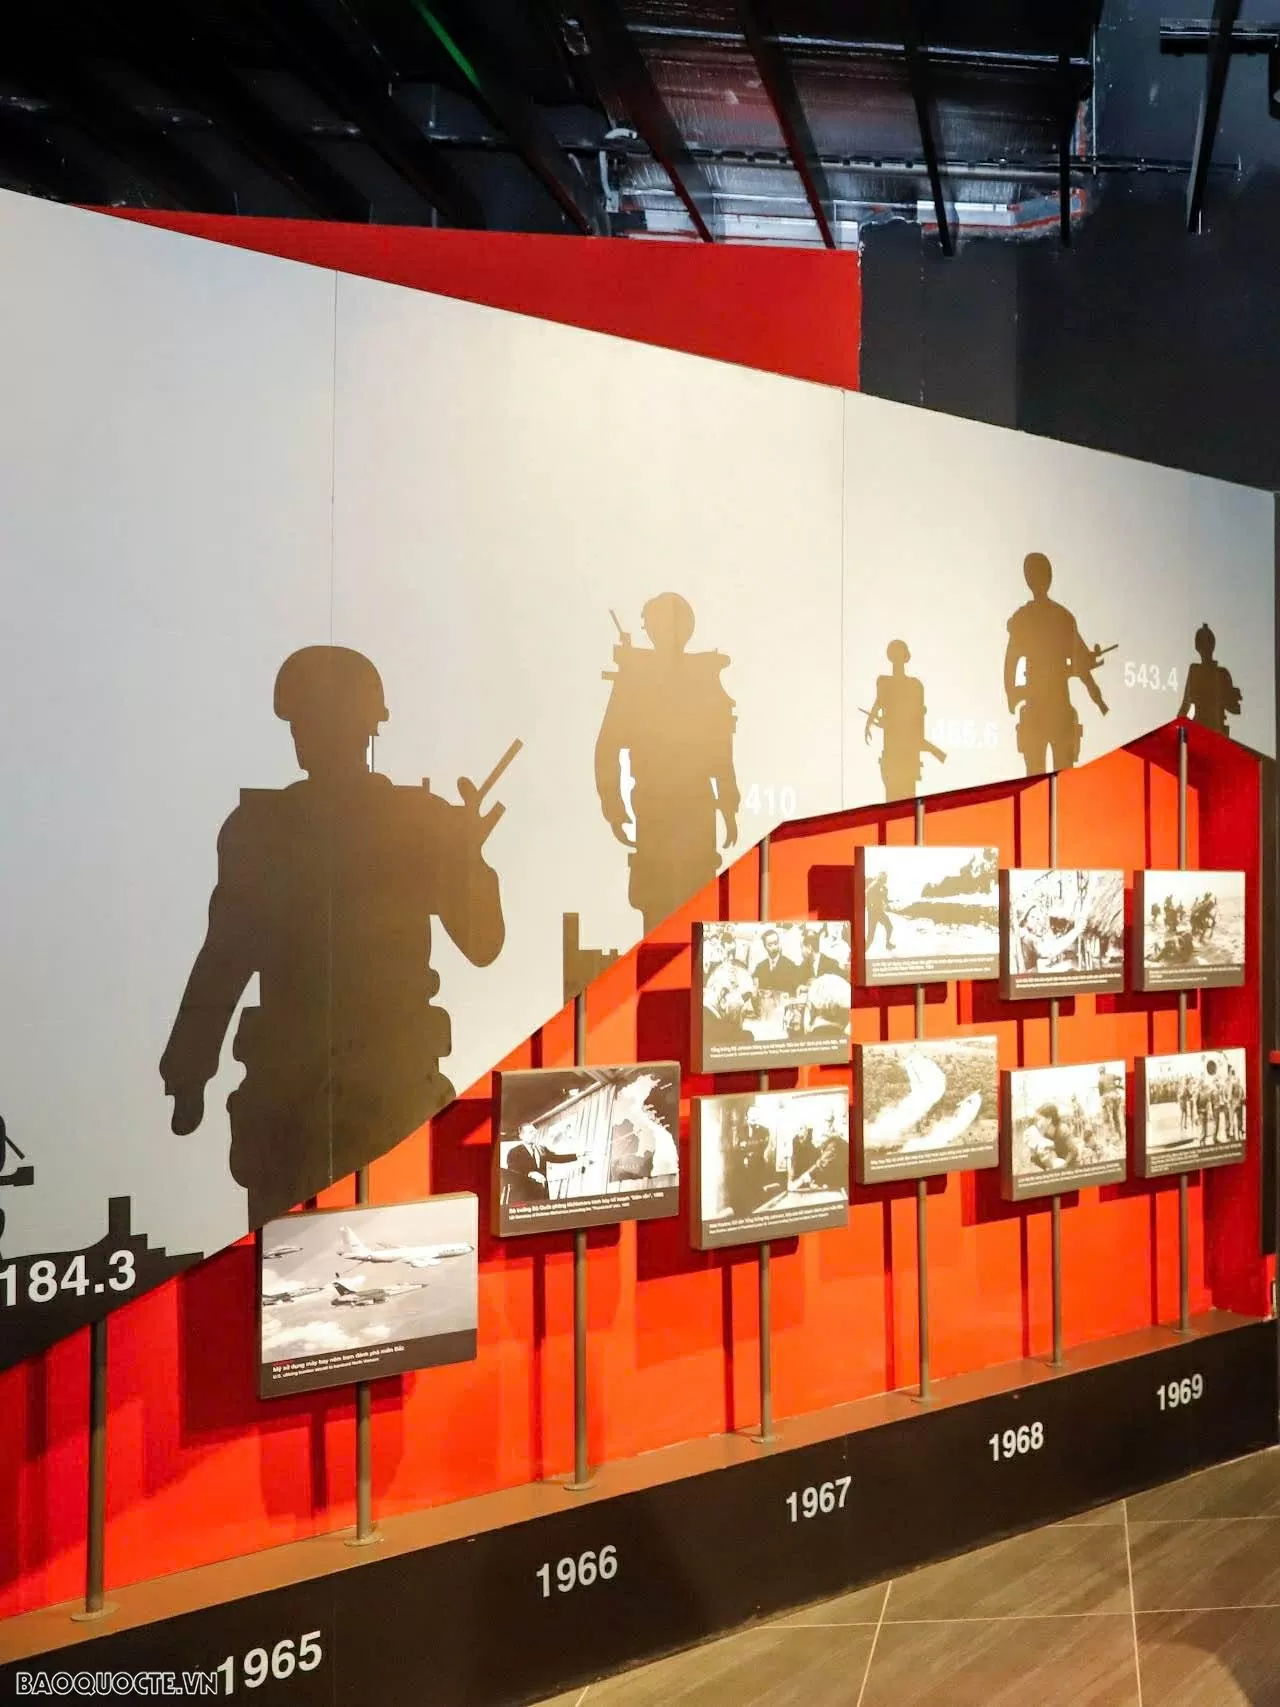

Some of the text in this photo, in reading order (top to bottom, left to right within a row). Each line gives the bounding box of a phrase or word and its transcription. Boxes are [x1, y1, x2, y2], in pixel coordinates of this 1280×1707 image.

[1124, 661, 1179, 693] 543.4
[745, 783, 797, 818] 410
[0, 1250, 136, 1307] 184.3
[1157, 1373, 1203, 1411] 1969
[989, 1421, 1044, 1462] 1968
[786, 1476, 851, 1523] 1967
[536, 1545, 618, 1599] 1966
[217, 1630, 322, 1696] 1965
